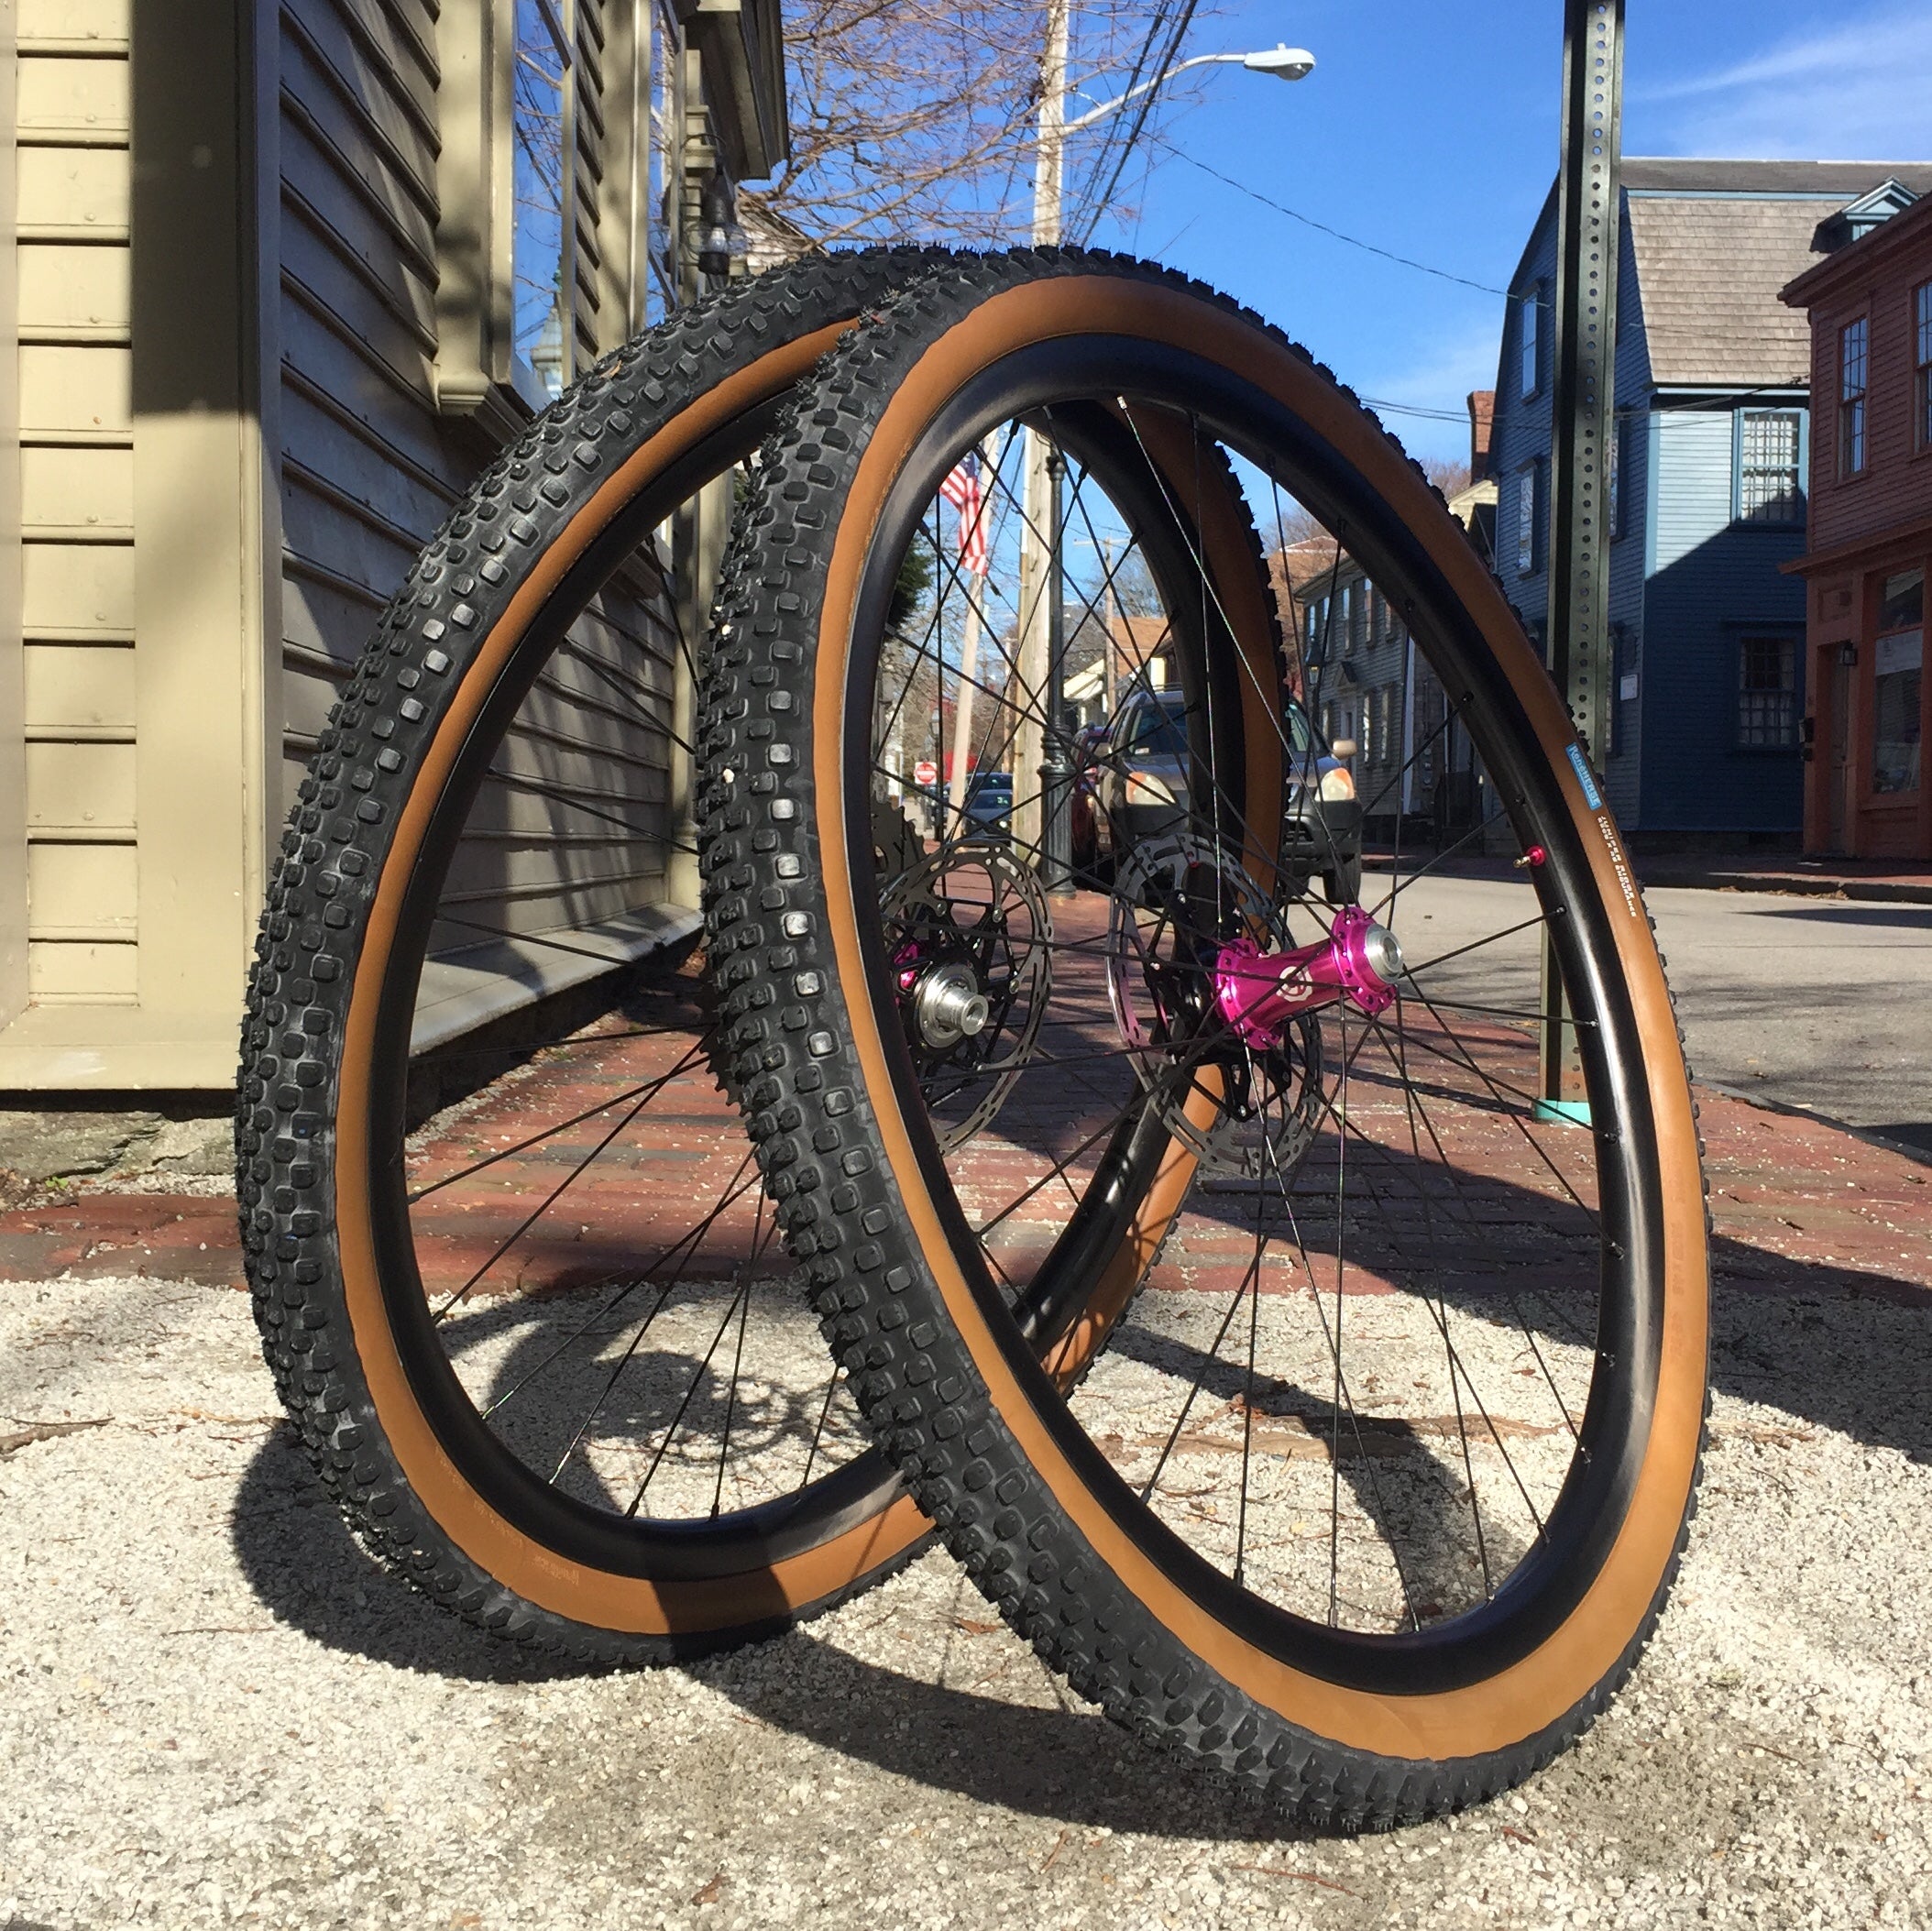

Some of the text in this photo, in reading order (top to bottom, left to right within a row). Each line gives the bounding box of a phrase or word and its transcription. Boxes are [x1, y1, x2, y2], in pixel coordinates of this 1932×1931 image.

[1600, 816, 1634, 898] JUNIPER RIDGE
[1615, 864, 1637, 917] ENDURANCE
